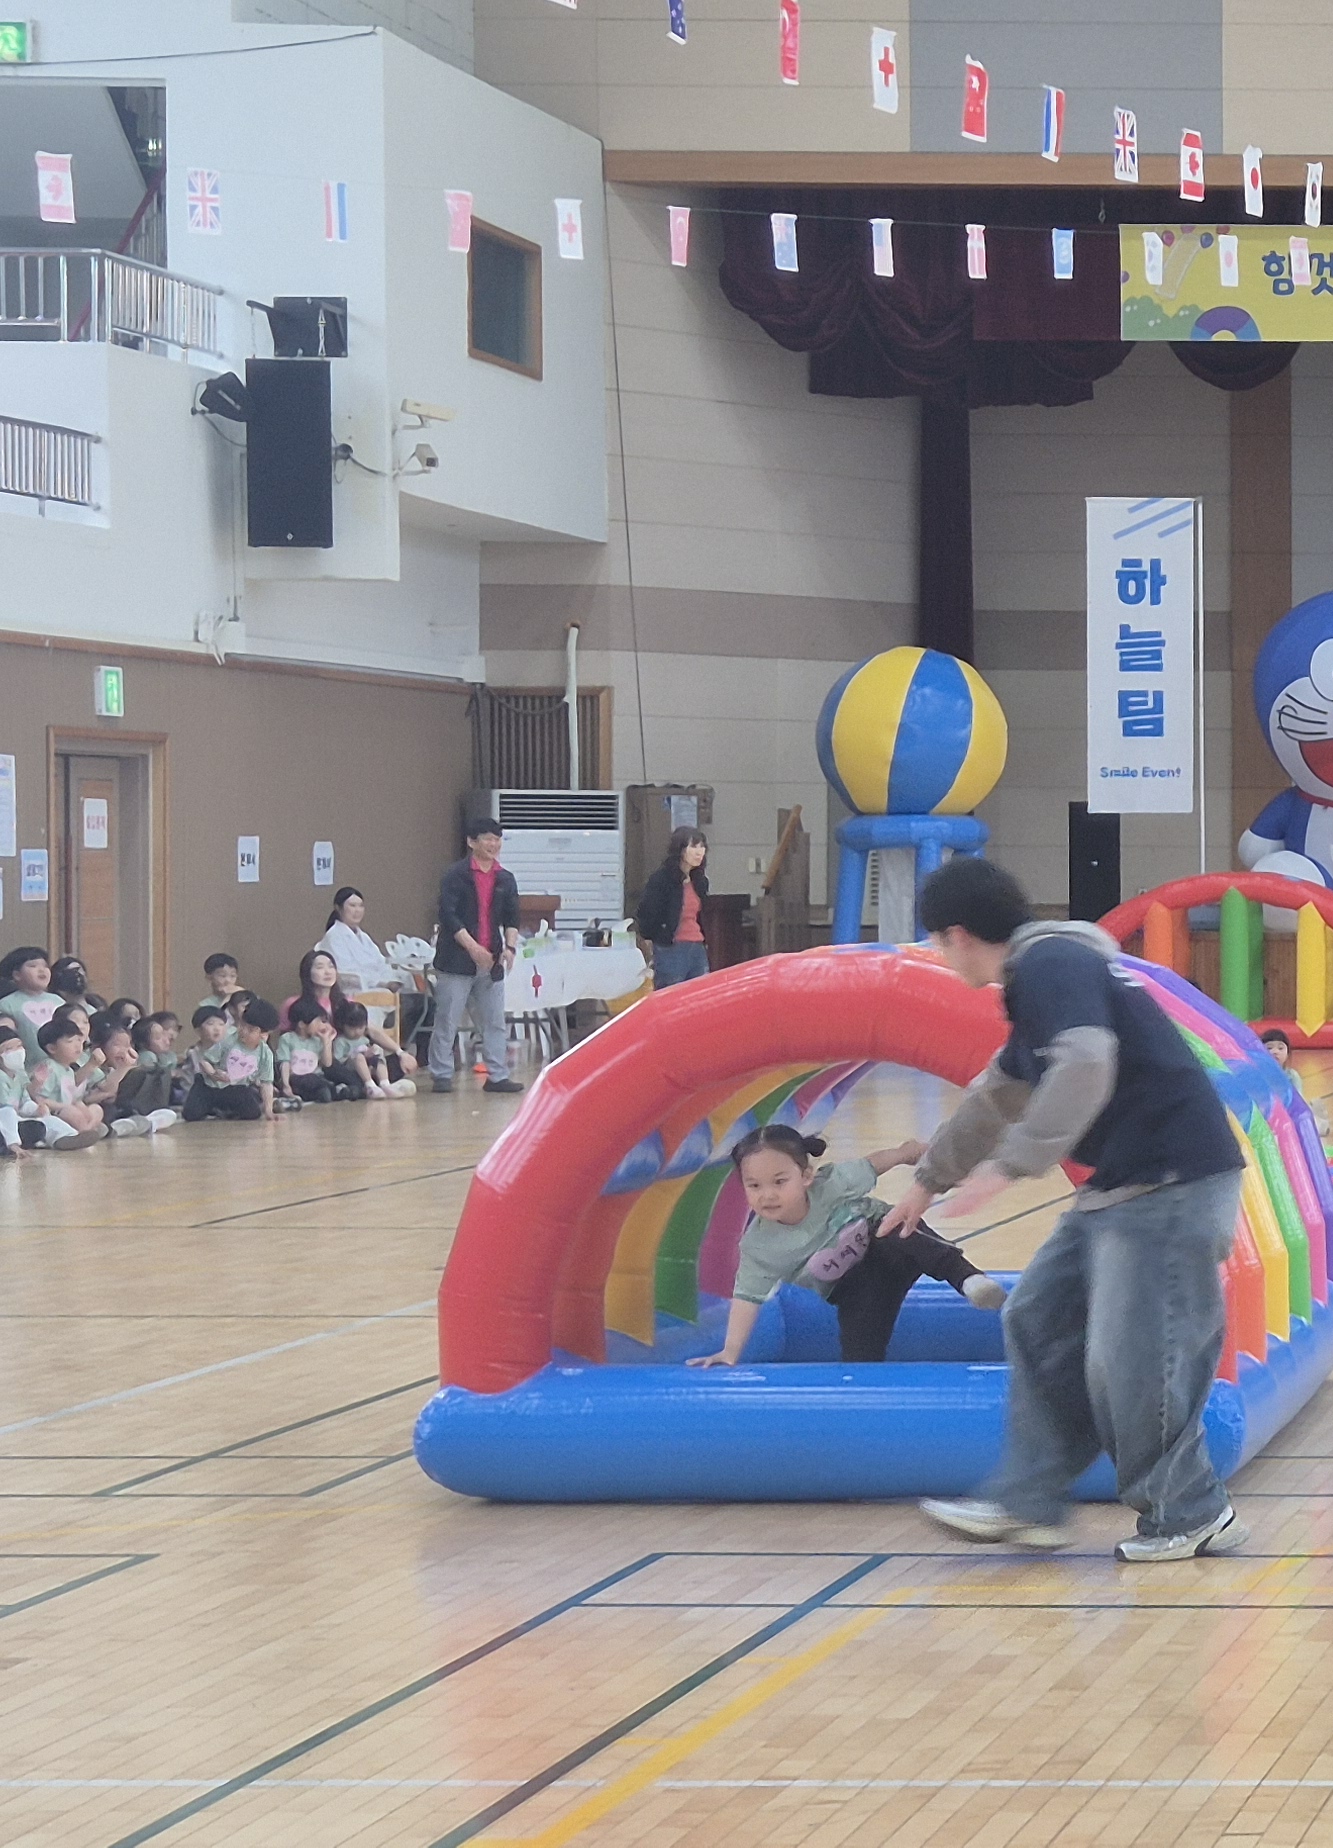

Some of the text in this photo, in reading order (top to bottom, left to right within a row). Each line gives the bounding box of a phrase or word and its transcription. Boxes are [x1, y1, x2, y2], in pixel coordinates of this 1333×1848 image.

[1115, 557, 1168, 738] 하늘팀
[1099, 766, 1182, 778] Smile Event
